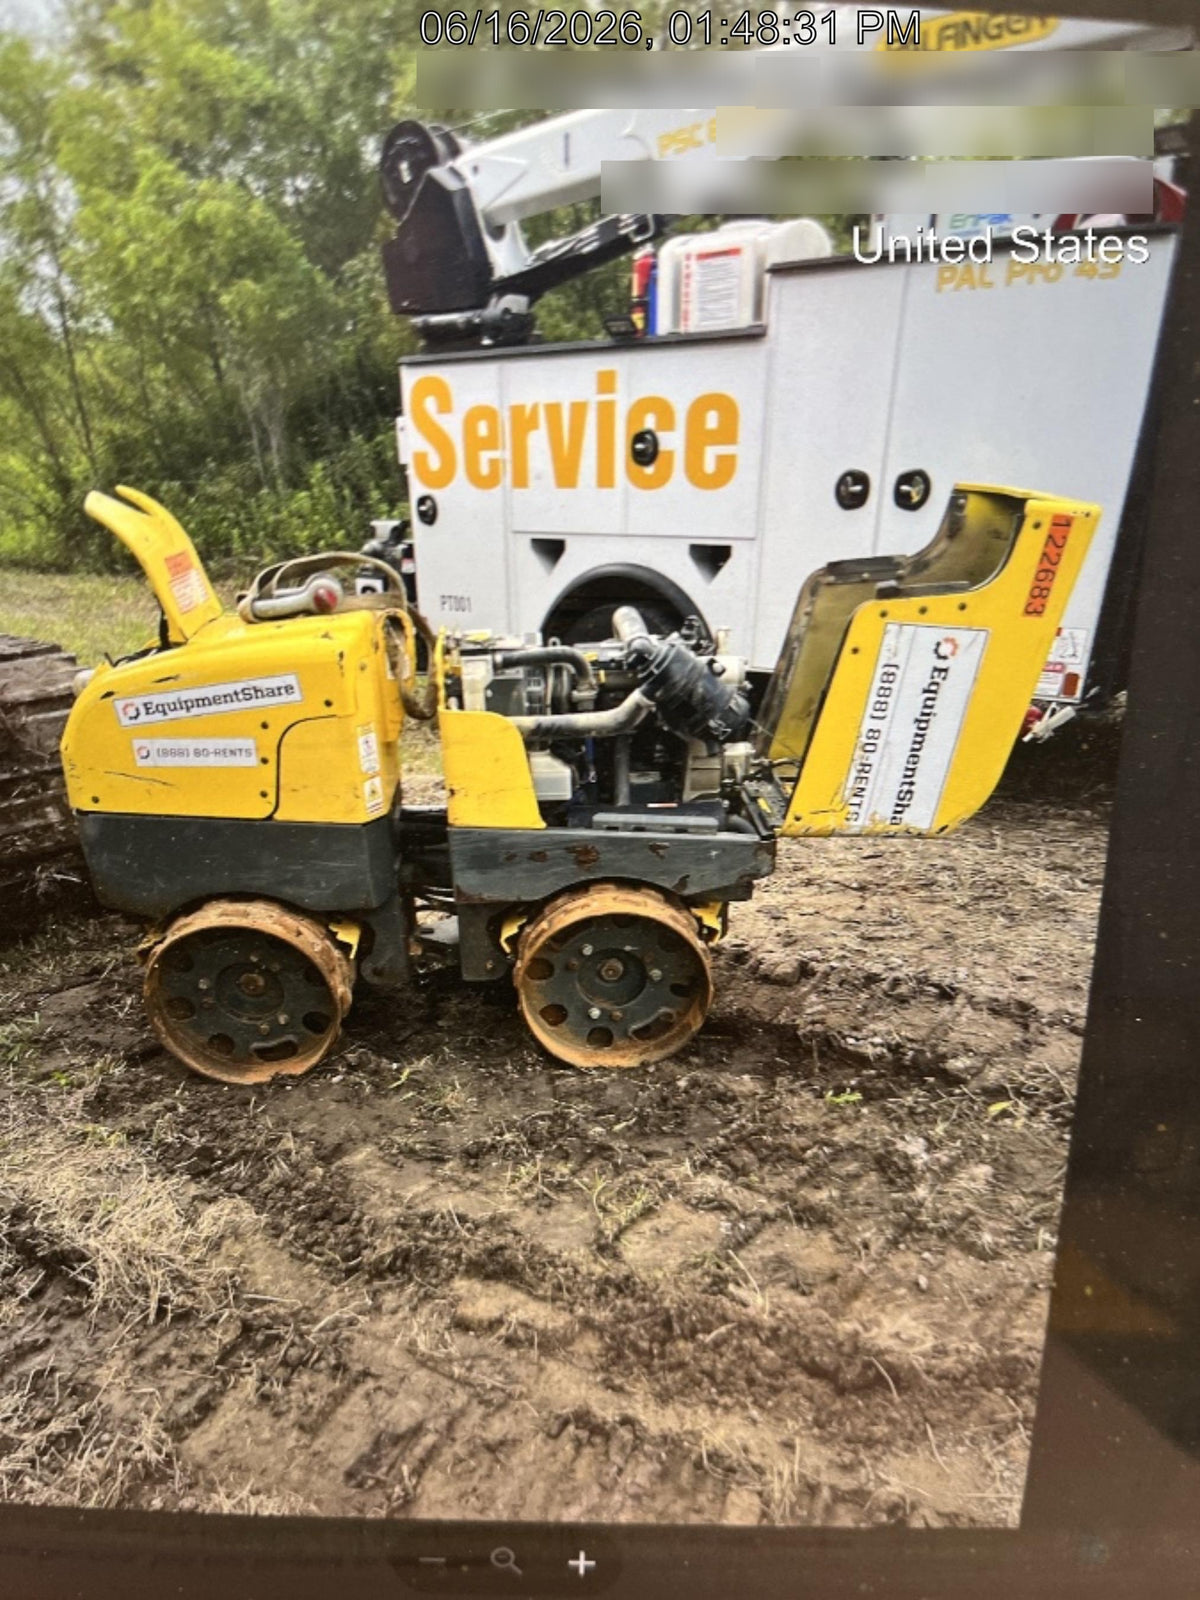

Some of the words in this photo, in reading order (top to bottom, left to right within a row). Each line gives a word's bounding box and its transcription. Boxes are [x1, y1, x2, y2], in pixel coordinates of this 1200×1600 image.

[936, 262, 995, 294] PAL
[1005, 259, 1064, 287] Pro
[409, 369, 740, 491] Service
[1024, 517, 1072, 616] 122683
[142, 683, 296, 717] EquipmentShare
[863, 663, 900, 721] (888)
[156, 746, 190, 759] (888)
[193, 747, 253, 759] 80-RENTS
[884, 665, 950, 838] EquipmentSha
